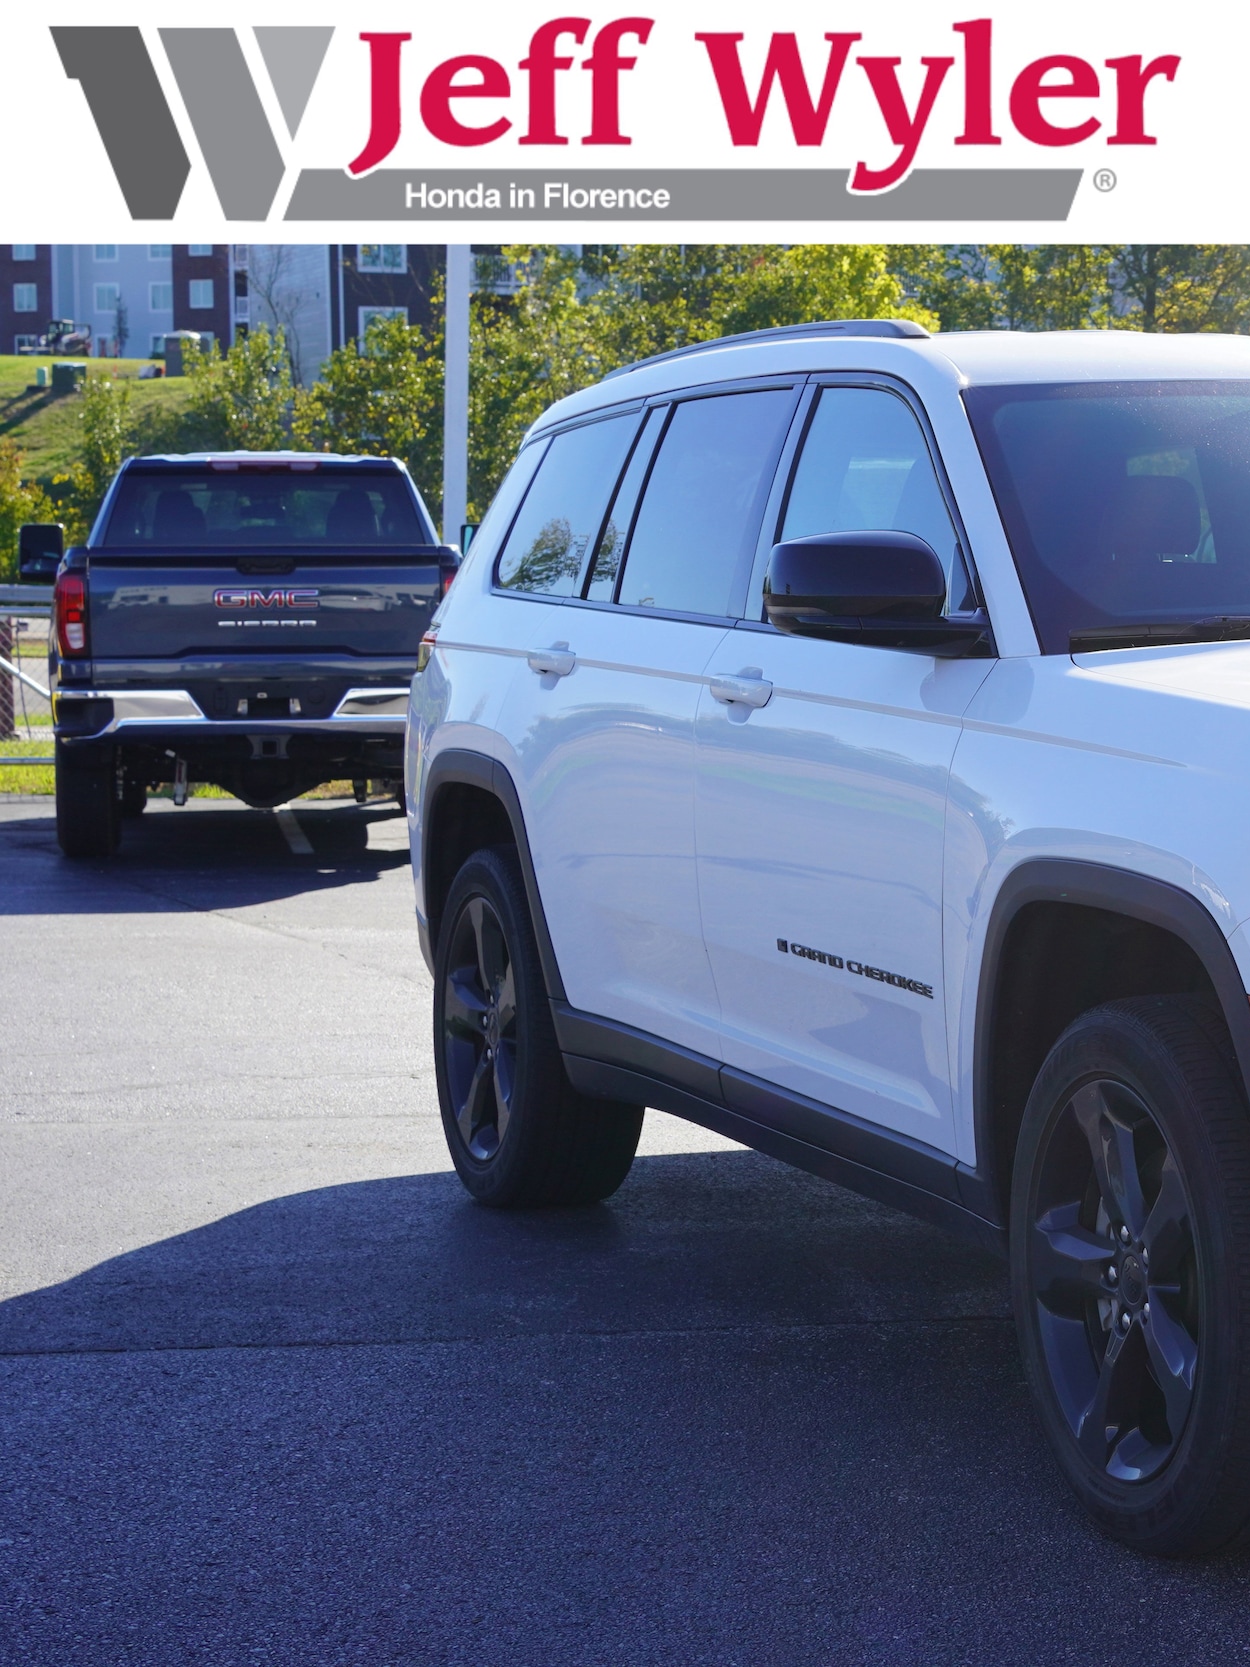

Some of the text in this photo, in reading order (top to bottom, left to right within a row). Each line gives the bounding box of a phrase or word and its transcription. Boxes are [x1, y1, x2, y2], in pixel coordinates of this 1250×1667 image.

[214, 589, 319, 609] GMC
[790, 942, 934, 1000] GRAND CHEROKEE
